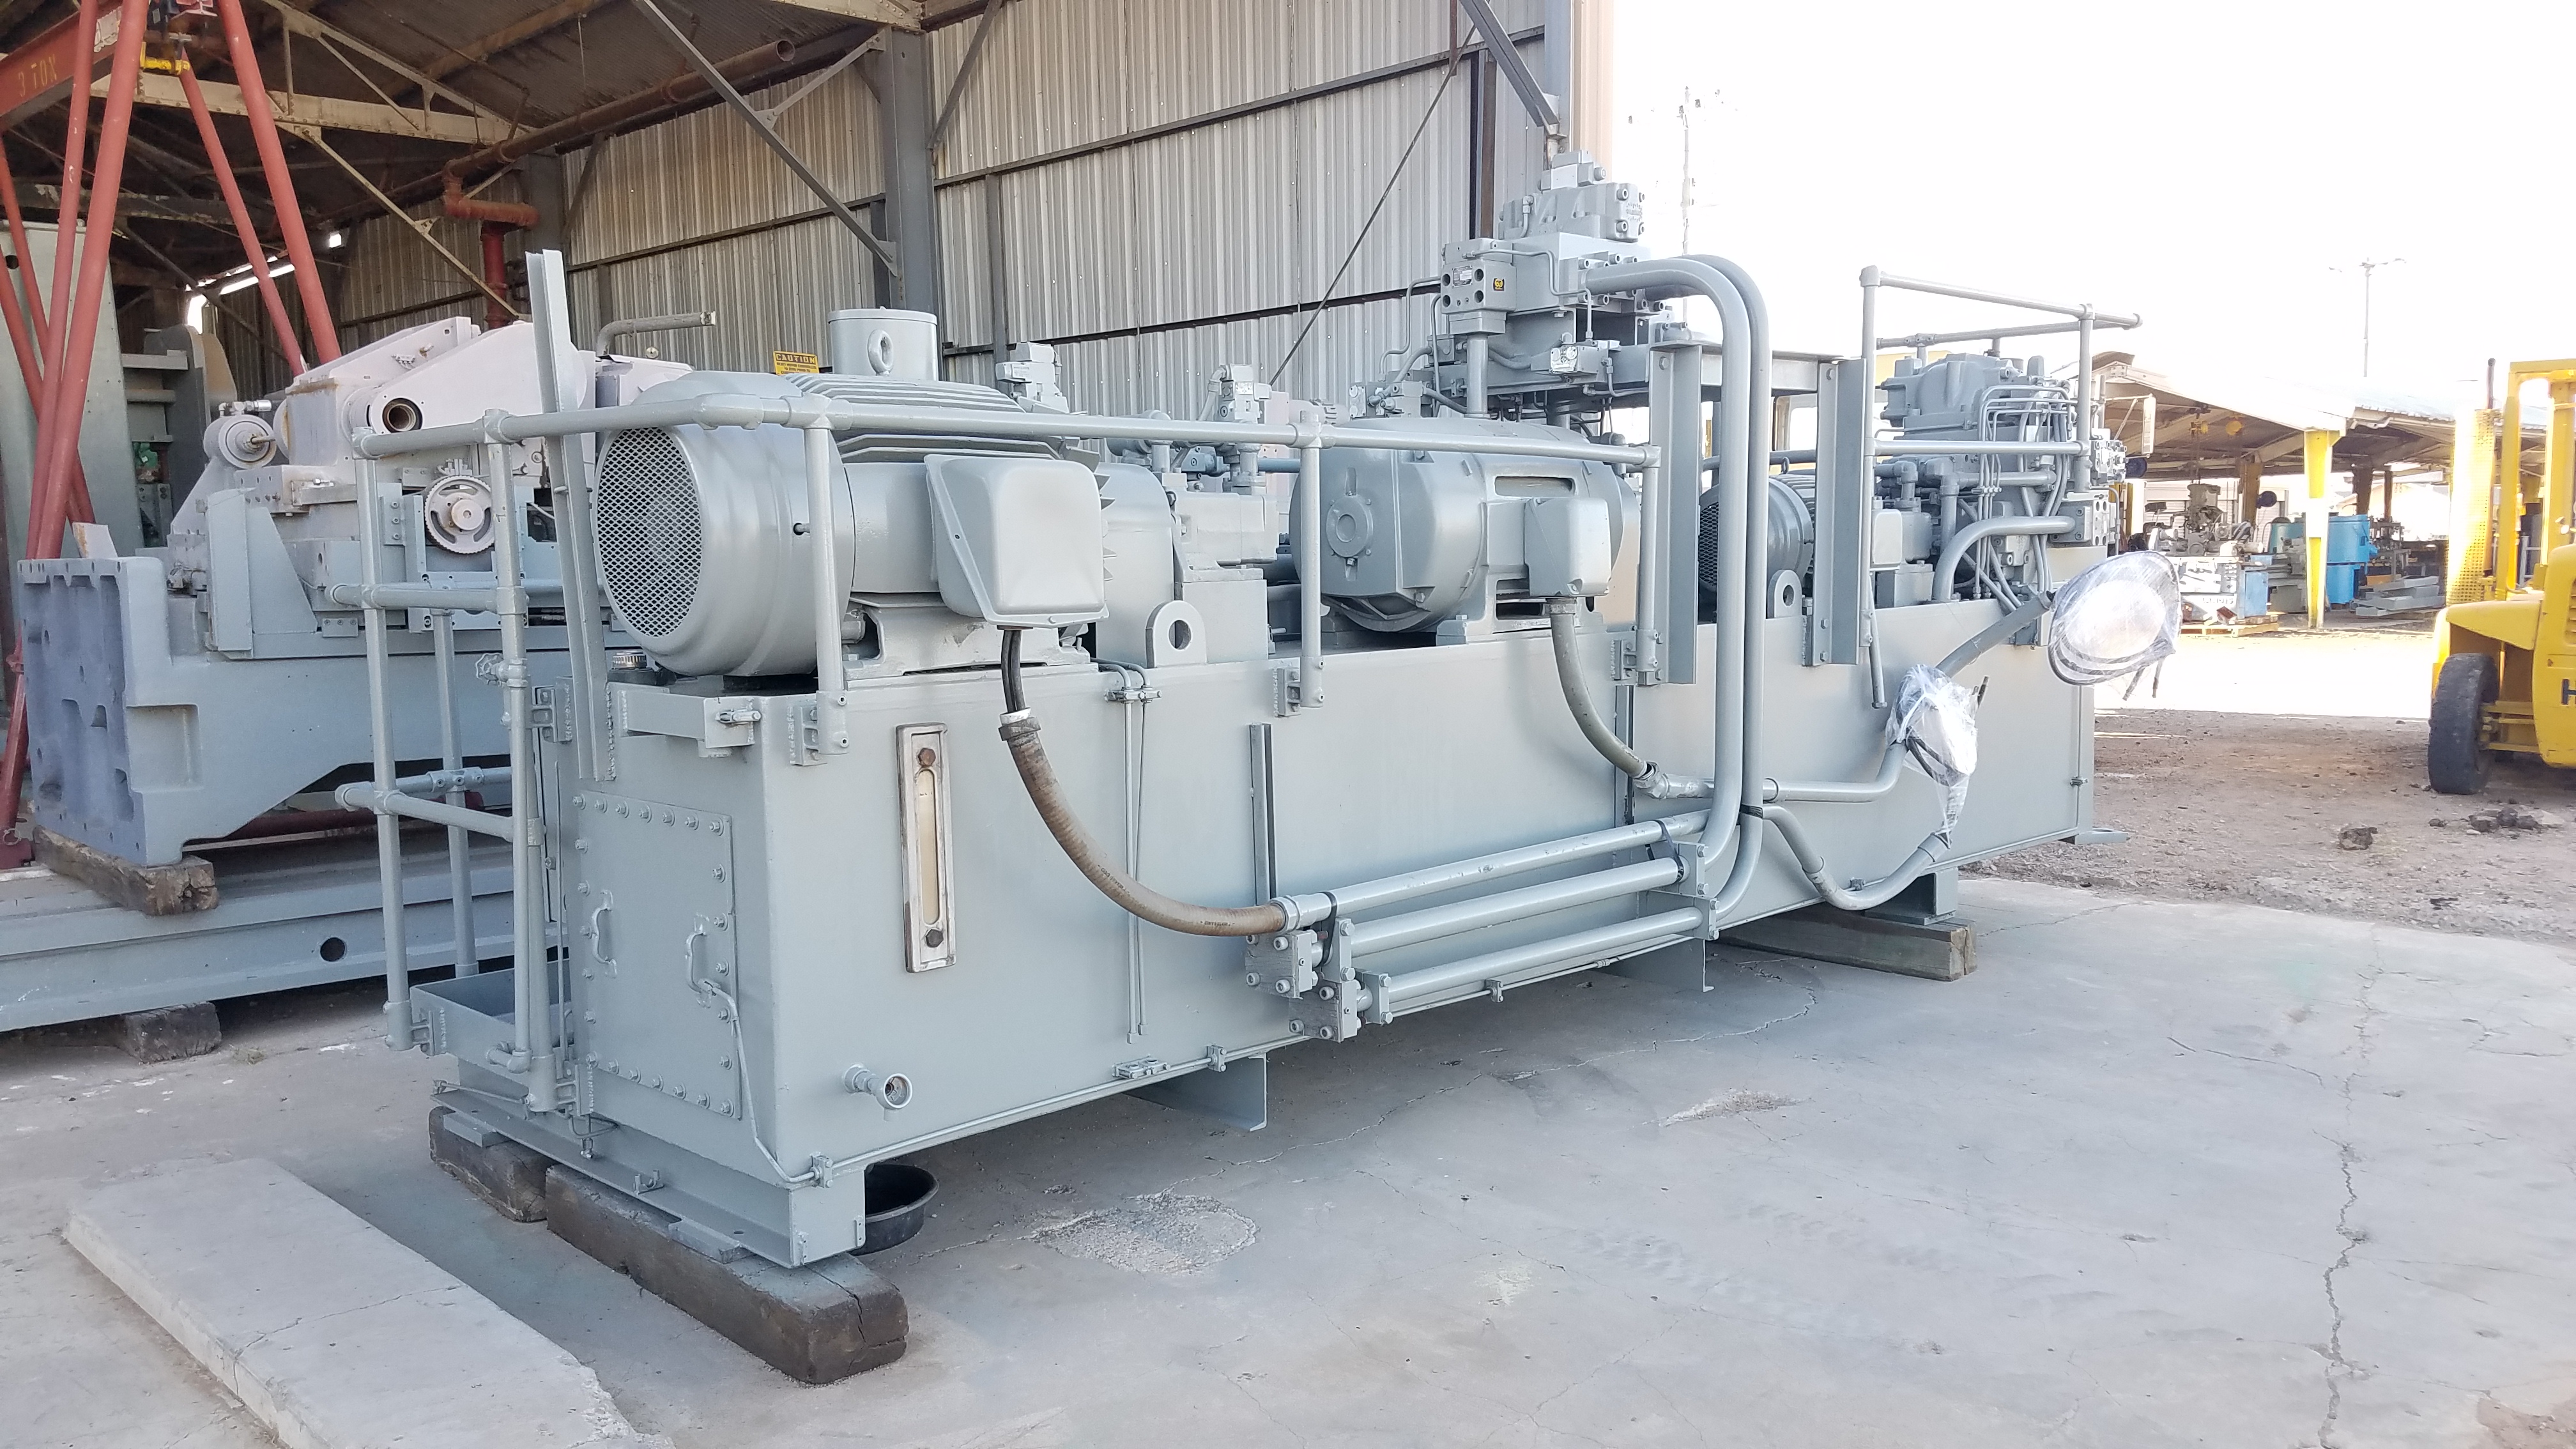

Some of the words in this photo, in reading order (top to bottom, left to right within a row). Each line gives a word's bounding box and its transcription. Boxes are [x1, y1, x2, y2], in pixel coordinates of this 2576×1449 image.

[18, 71, 26, 97] 3
[31, 54, 57, 89] TON
[776, 353, 816, 364] CAUTION
